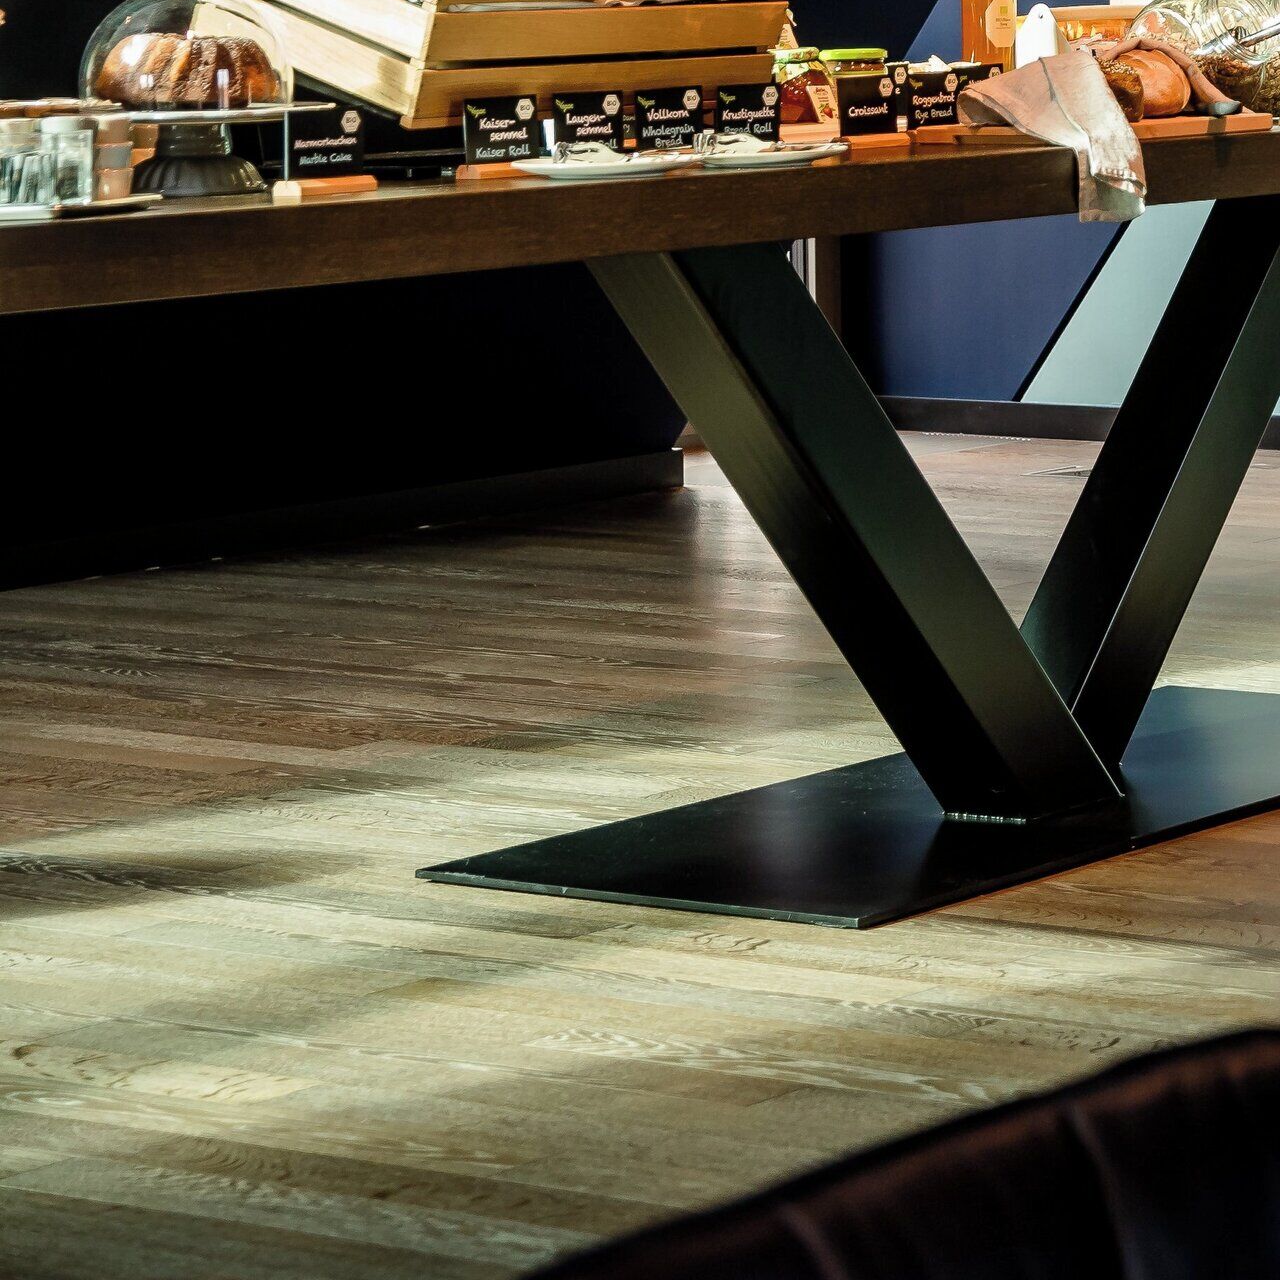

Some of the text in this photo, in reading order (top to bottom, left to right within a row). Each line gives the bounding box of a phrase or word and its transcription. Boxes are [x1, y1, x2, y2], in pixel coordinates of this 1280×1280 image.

[912, 91, 955, 108] Roggenbrot
[647, 108, 690, 122] Vollkorn
[722, 107, 776, 122] Krustiguette
[848, 102, 889, 118] Croissant
[915, 106, 954, 124] Rye Bread
[479, 117, 517, 132] Kaiser-
[565, 112, 606, 128] Laugen-
[753, 121, 773, 134] Roll
[489, 127, 529, 142] semmel
[575, 122, 614, 138] semmel
[642, 123, 695, 139] Wholegrain
[655, 134, 684, 149] Bread
[475, 143, 531, 160] Kaiser Roll
